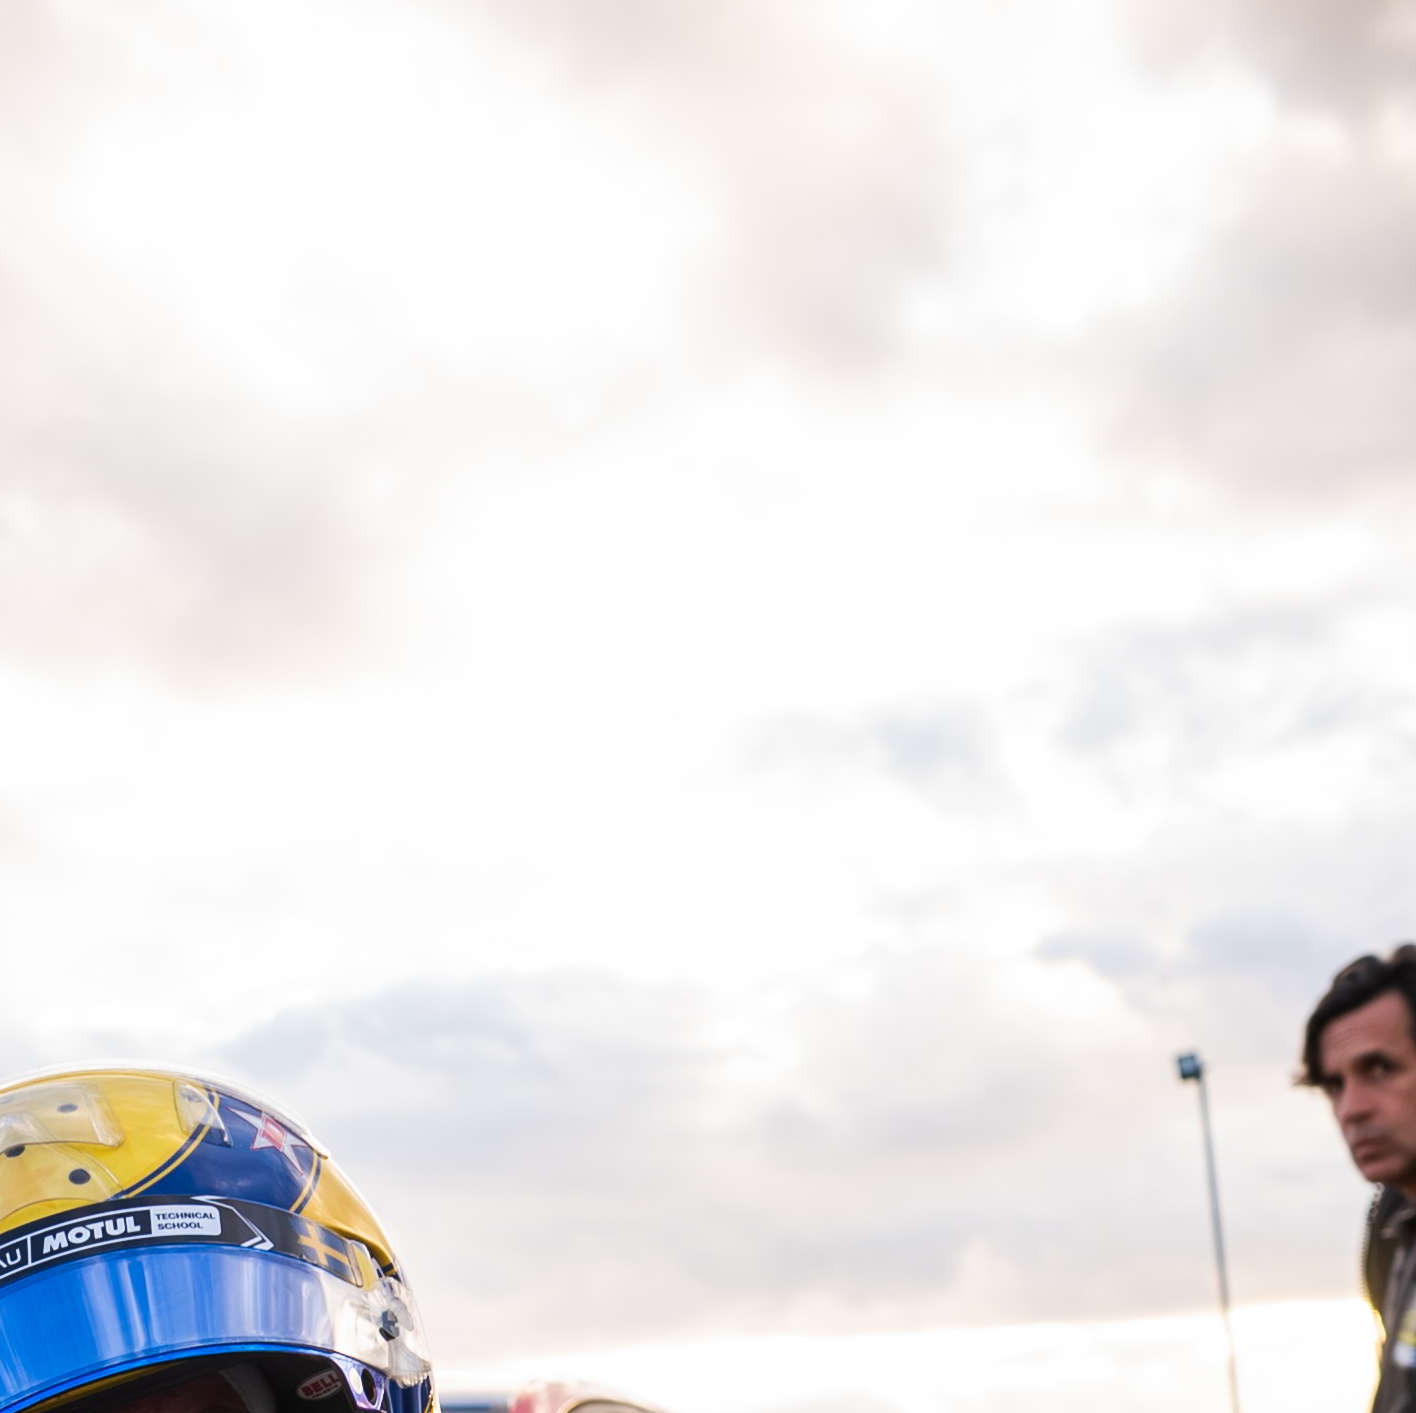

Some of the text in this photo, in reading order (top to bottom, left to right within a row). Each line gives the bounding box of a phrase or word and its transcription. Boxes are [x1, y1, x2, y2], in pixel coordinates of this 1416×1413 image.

[154, 1211, 216, 1222] TECHNICAL
[157, 1221, 204, 1231] SCHOOL
[42, 1215, 141, 1255] MOTUL
[301, 1374, 339, 1397] BELL
